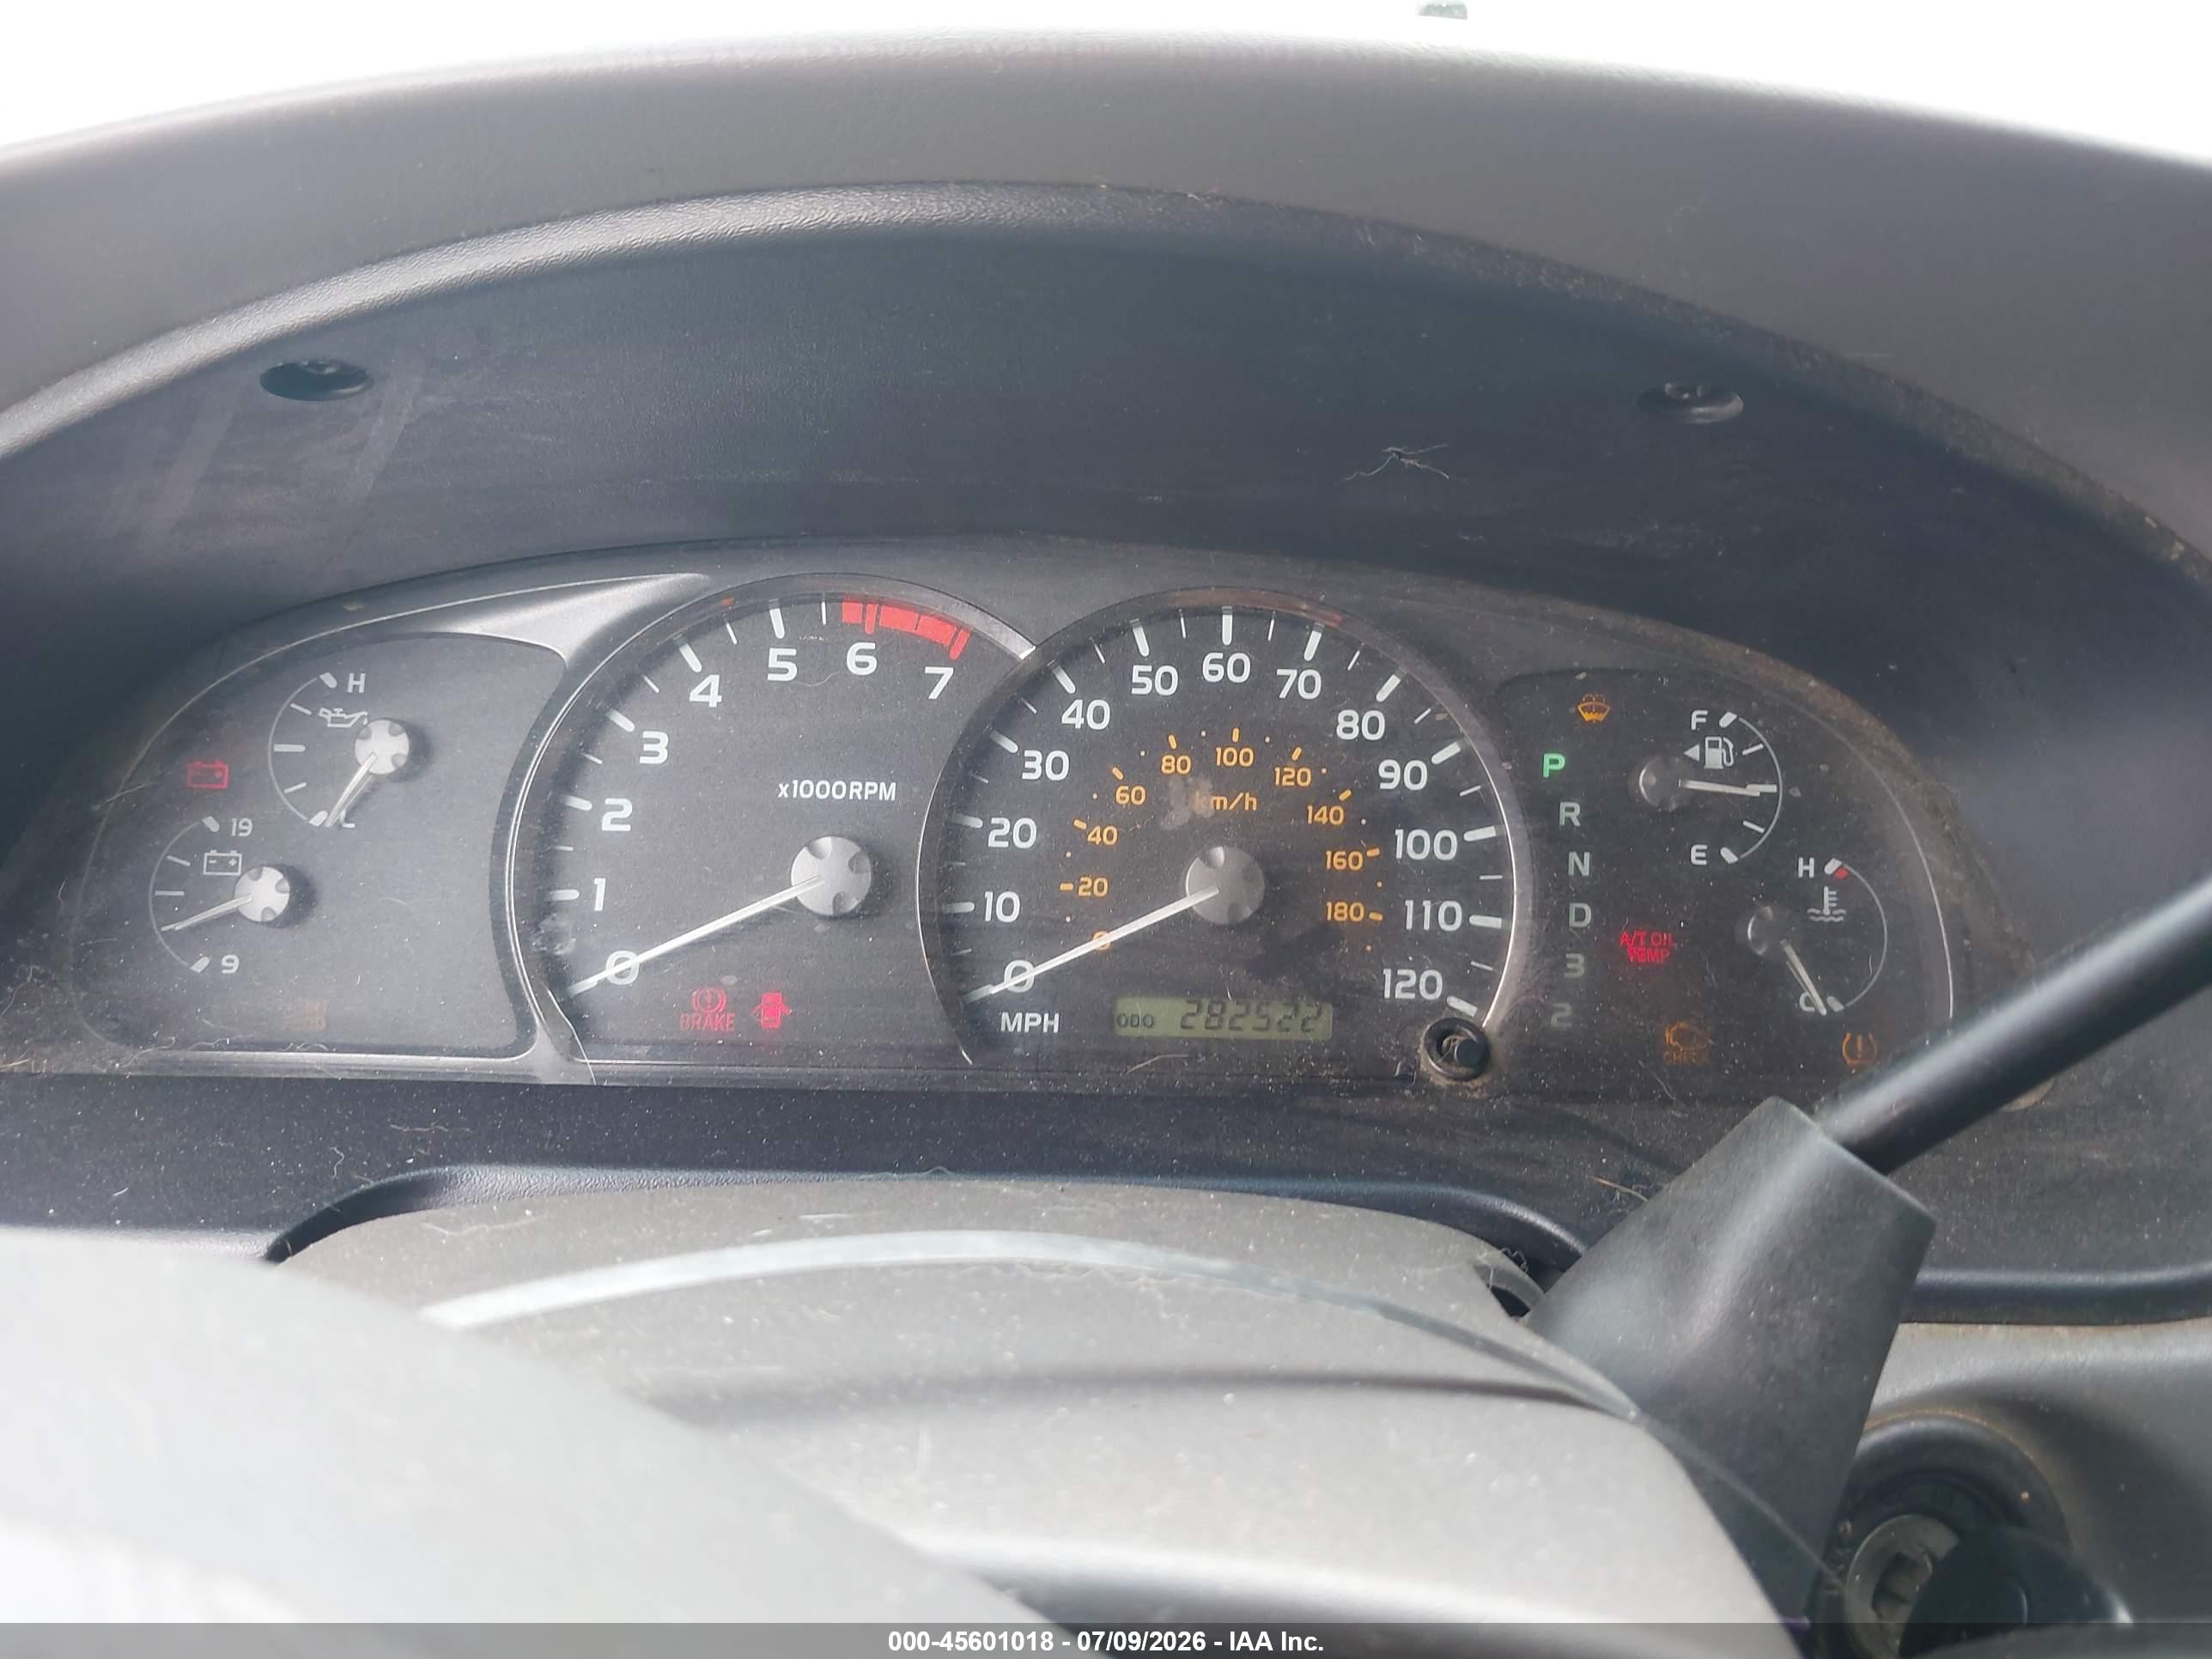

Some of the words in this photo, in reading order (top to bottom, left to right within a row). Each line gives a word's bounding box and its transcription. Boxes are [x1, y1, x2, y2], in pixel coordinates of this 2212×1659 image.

[767, 648, 798, 681] 5
[846, 643, 878, 676] 6
[1203, 652, 1251, 684] 60
[348, 673, 366, 693] H
[689, 675, 721, 708] 4
[924, 667, 953, 699] 7
[1131, 665, 1179, 696] 50
[1277, 669, 1322, 699] 70
[1061, 699, 1111, 731] 40
[1336, 709, 1386, 741] 80
[1691, 710, 1708, 730] F
[640, 732, 669, 764] 3
[1215, 747, 1255, 767] 100
[1022, 750, 1070, 781] 30
[1161, 755, 1192, 775] 80
[1274, 767, 1311, 787] 120
[1377, 760, 1428, 791] 90
[1543, 753, 1565, 777] P
[1115, 786, 1146, 805] 60
[602, 798, 633, 831] 2
[1306, 805, 1345, 825] 140
[1559, 802, 1581, 827] R
[231, 818, 252, 837] 19
[988, 817, 1037, 848] 20
[1086, 826, 1117, 846] 40
[1394, 829, 1458, 860] 100
[1691, 845, 1708, 866] E
[1325, 850, 1363, 870] 160
[1568, 853, 1590, 877] N
[1798, 858, 1814, 878] H
[593, 878, 606, 911] 1
[1078, 878, 1109, 896] 20
[983, 890, 1020, 922] 10
[1326, 902, 1364, 921] 180
[1404, 900, 1462, 931] 110
[1570, 903, 1591, 927] D
[1620, 930, 1646, 946] A/T
[222, 955, 240, 974] 9
[1565, 955, 1585, 979] 3
[1627, 947, 1670, 963] TEMP
[605, 951, 640, 985] 0
[1004, 959, 1036, 993] 0
[1382, 969, 1443, 1000] 120
[679, 1013, 736, 1031] BRAKE
[1000, 1012, 1060, 1034] MPH
[1116, 1013, 1154, 1029] ODO
[1180, 1000, 1322, 1033] 282522
[1551, 1004, 1572, 1028] 2
